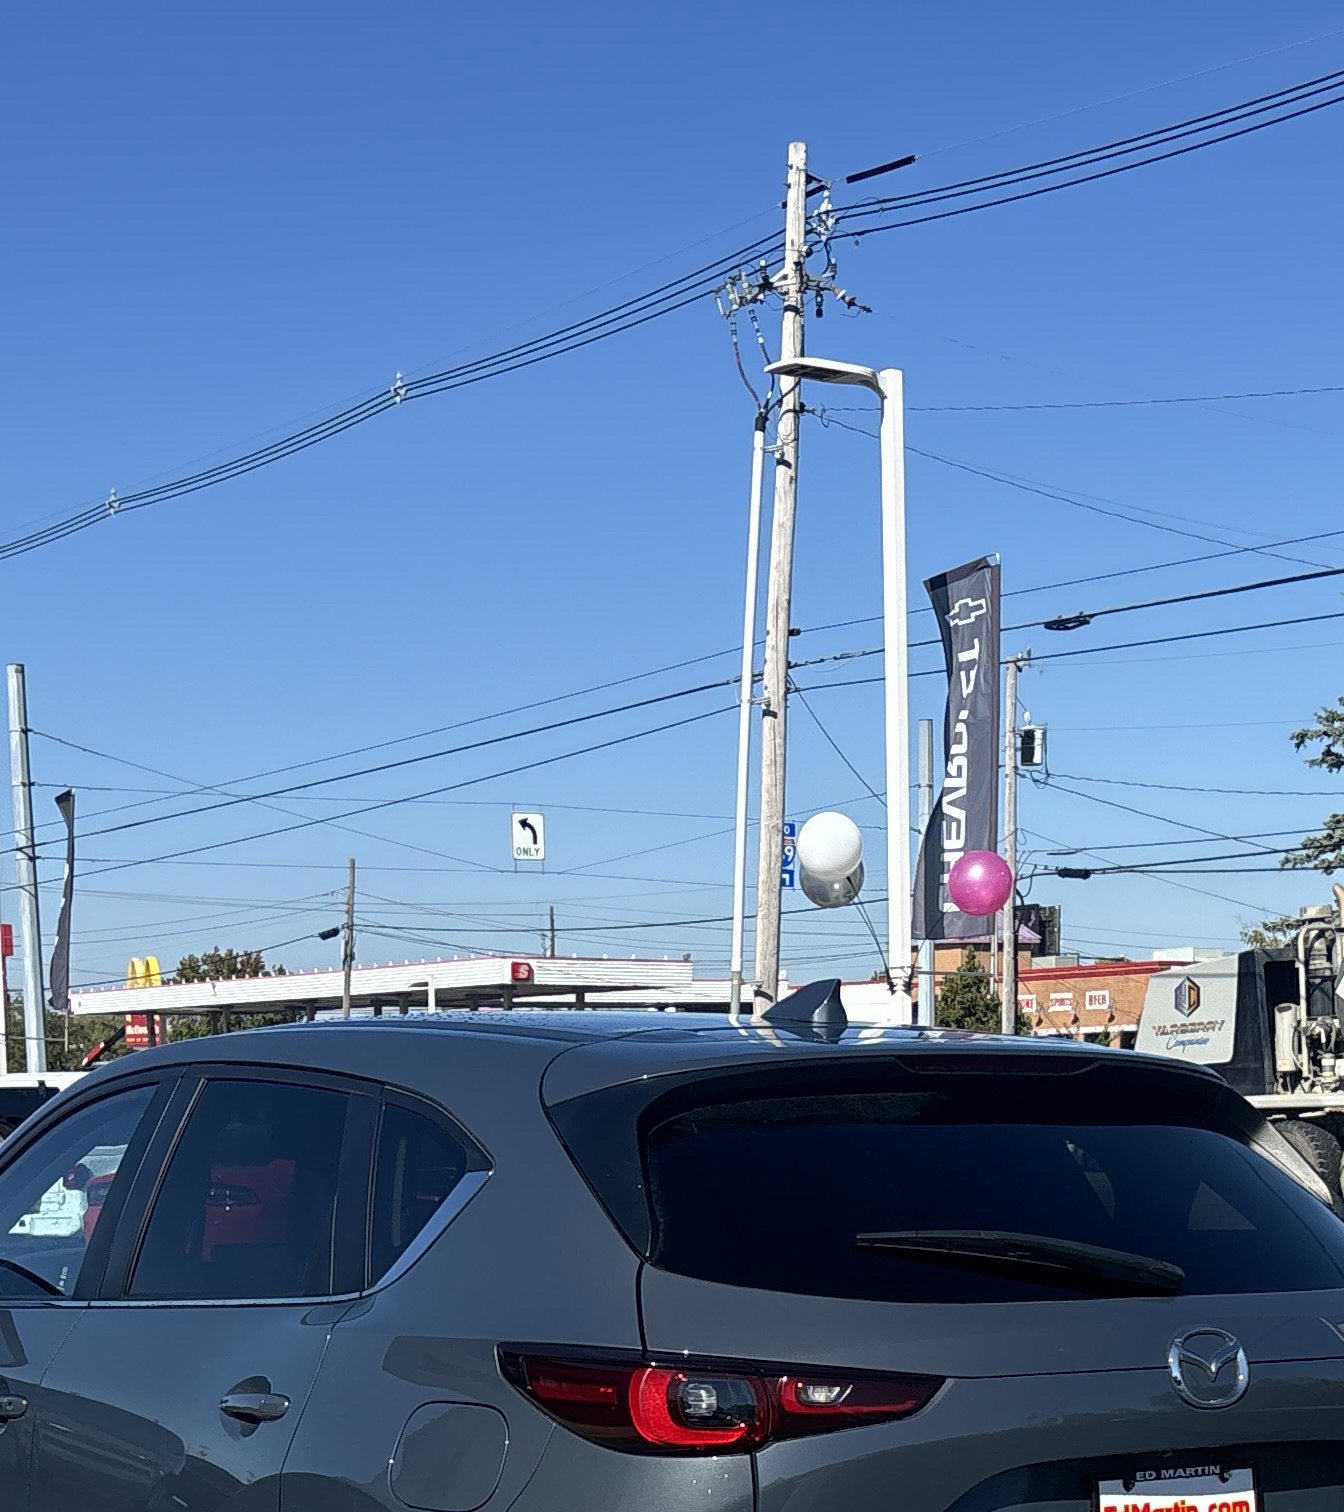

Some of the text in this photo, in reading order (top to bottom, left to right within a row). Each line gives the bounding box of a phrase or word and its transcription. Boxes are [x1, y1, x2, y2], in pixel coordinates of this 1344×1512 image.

[516, 846, 541, 857] ONLY
[1135, 1465, 1221, 1481] ED MARTIN
